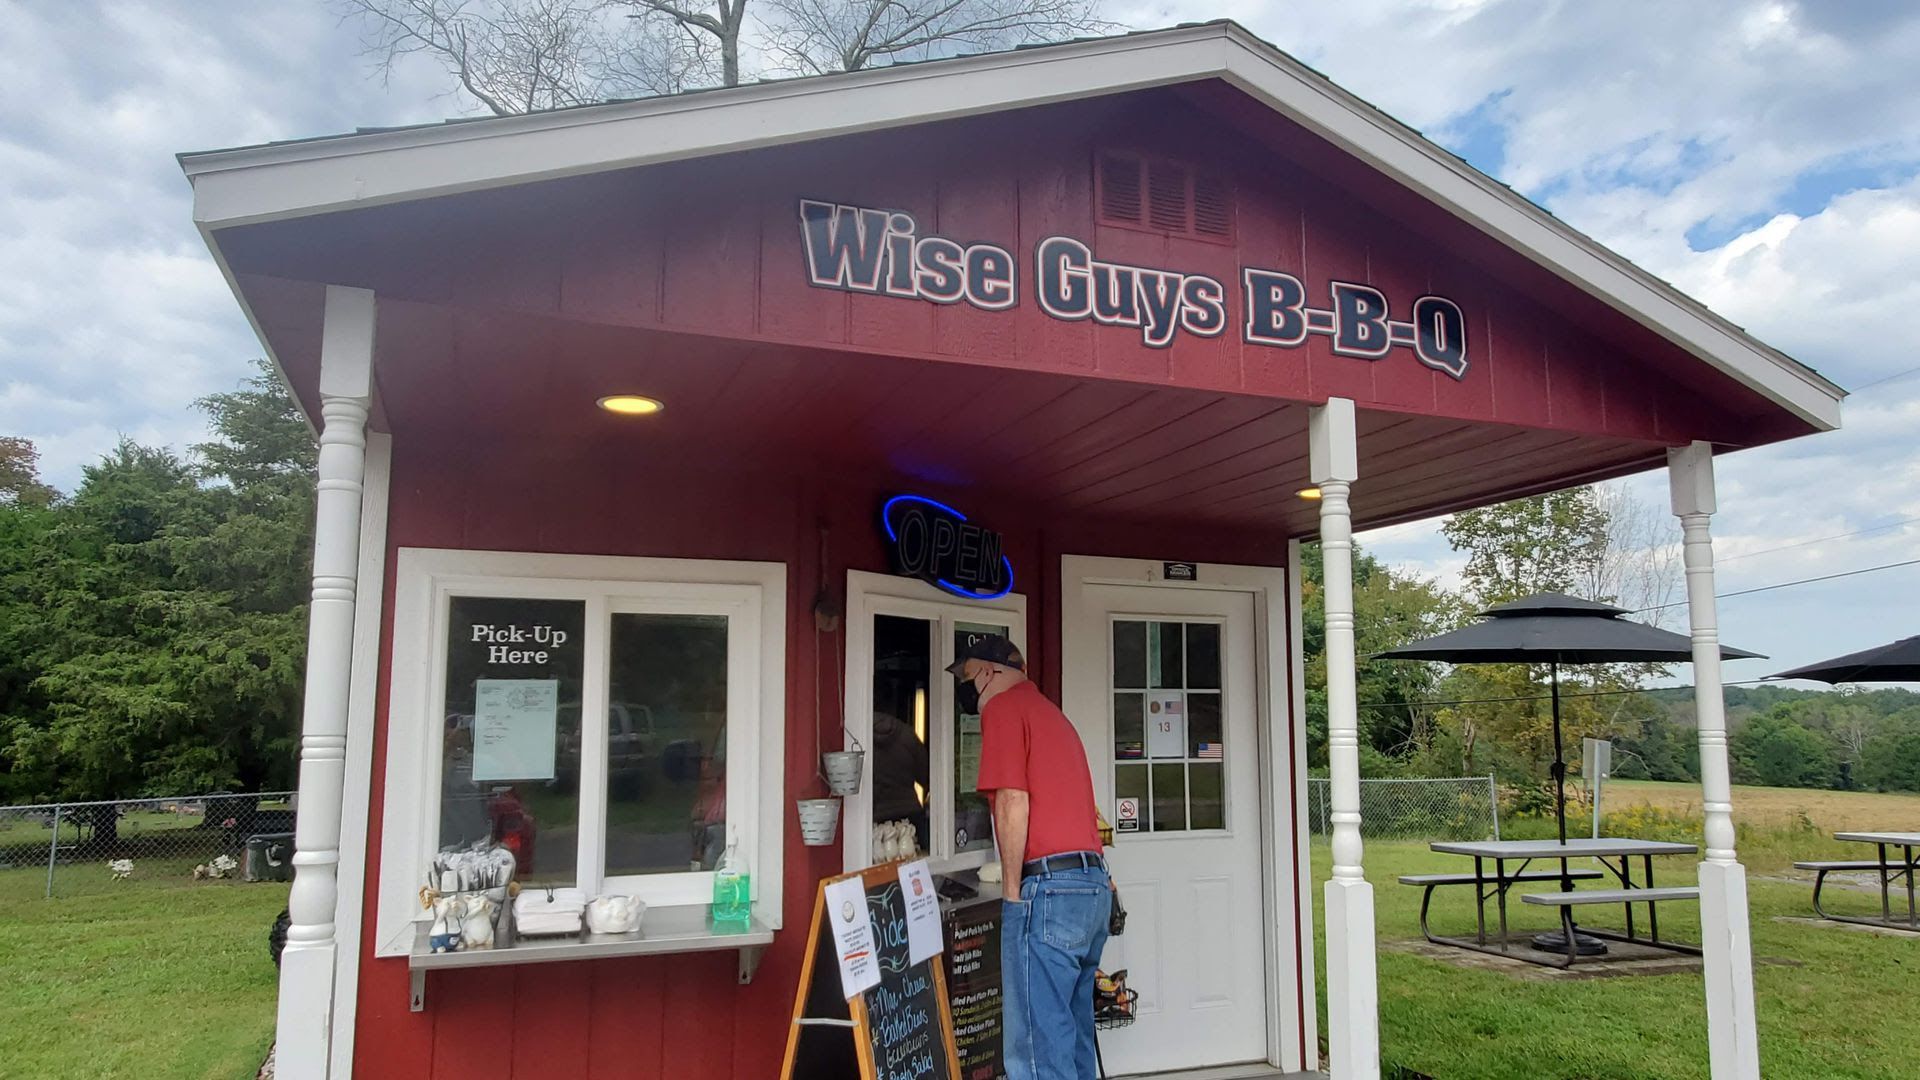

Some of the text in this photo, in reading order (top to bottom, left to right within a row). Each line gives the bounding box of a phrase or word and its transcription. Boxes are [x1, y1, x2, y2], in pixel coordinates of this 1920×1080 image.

[799, 199, 1468, 376] Wise Guys B-B-Q
[898, 509, 1003, 585] OPEN
[471, 624, 567, 648] Pick-Up
[487, 645, 549, 664] Here
[1158, 721, 1171, 733] 13
[952, 996, 966, 1006] ulled
[956, 1048, 968, 1057] late
